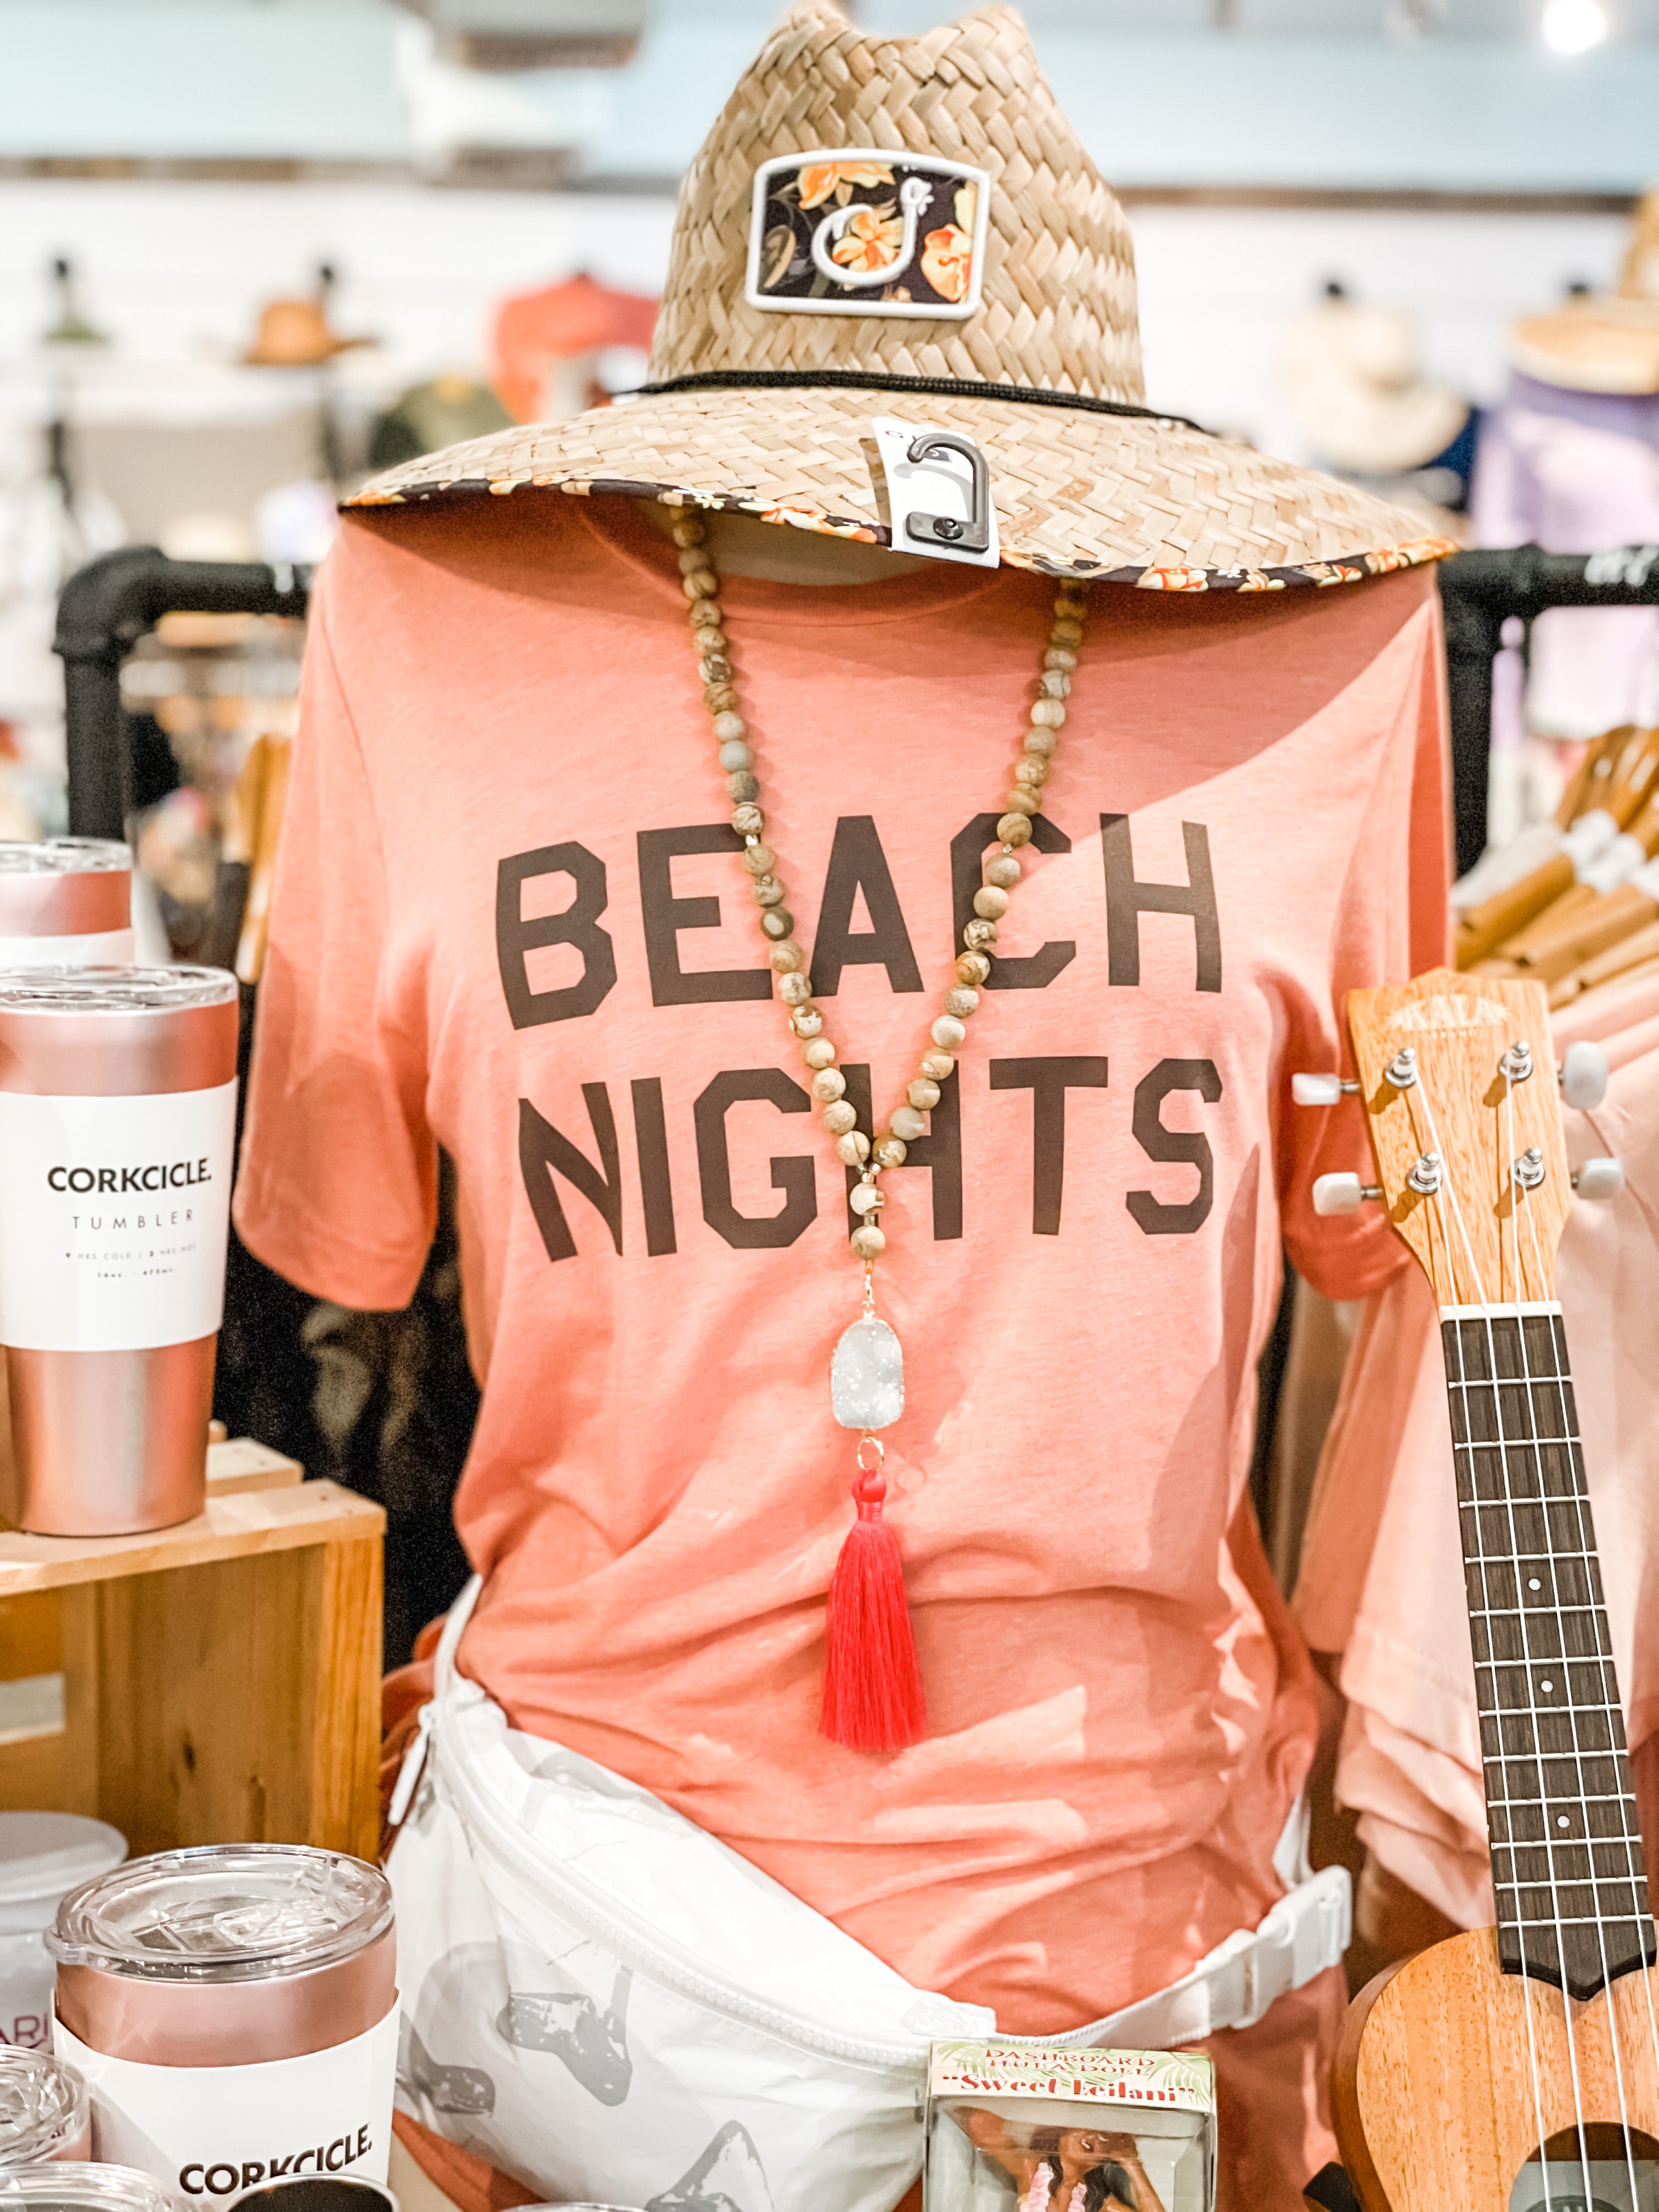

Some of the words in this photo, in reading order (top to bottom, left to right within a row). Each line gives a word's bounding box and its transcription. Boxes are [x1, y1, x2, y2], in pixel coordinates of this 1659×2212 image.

[495, 812, 1221, 1030] BEACH
[1402, 994, 1504, 1031] KALA
[518, 1056, 1223, 1262] NIGHTS
[72, 1209, 193, 1229] TUMBLER
[986, 2049, 1155, 2067] DASHBOARD
[990, 2059, 1066, 2071] HULA
[1081, 2064, 1150, 2076] DOLL
